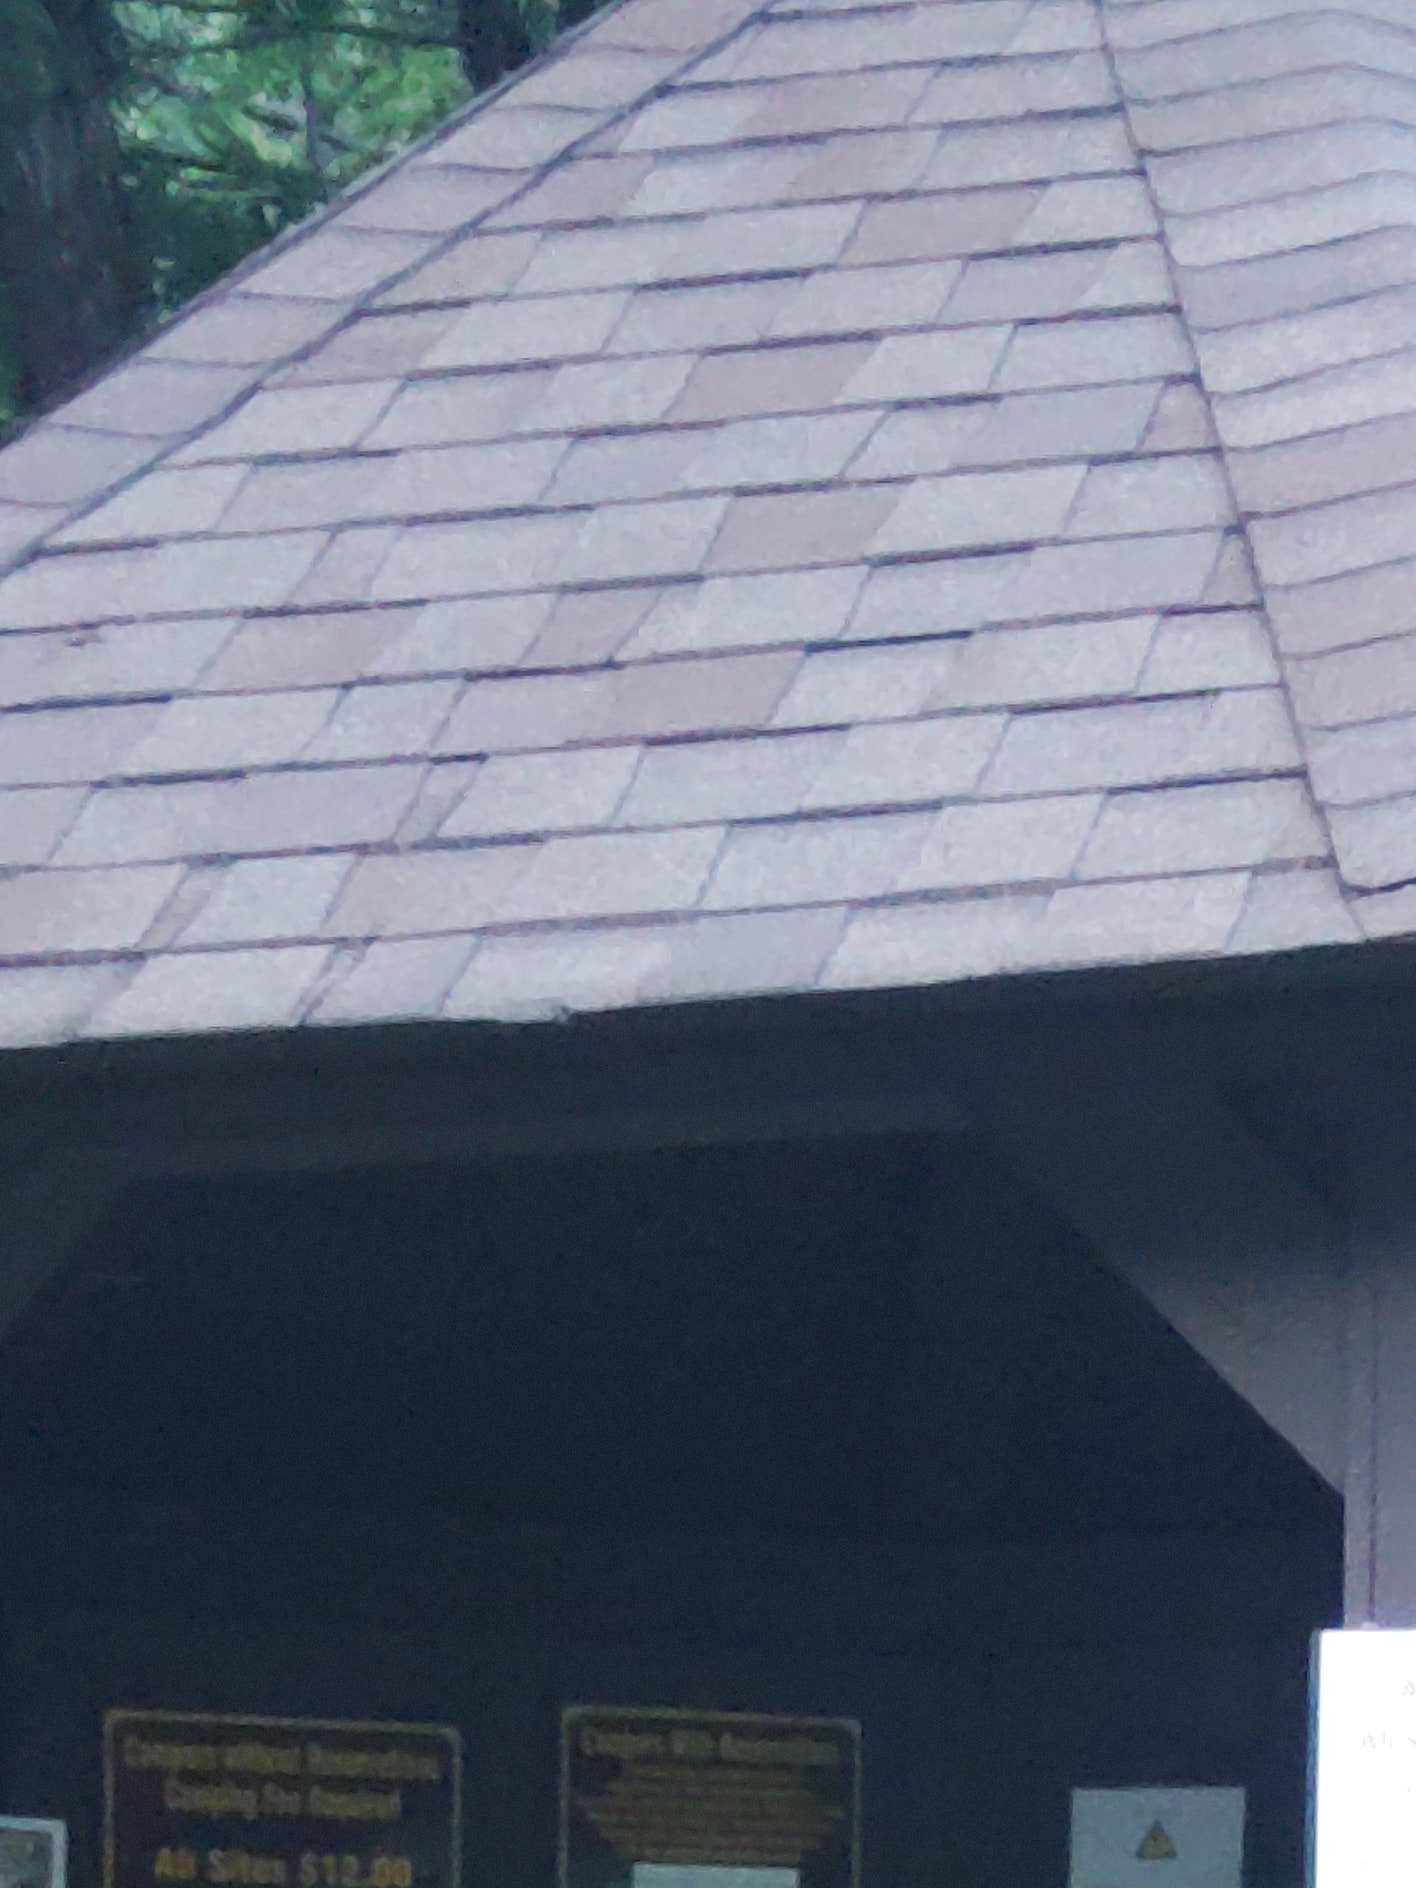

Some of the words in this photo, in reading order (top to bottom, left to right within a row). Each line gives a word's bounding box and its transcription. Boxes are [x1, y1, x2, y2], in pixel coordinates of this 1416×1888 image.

[154, 1848, 197, 1881] All
[206, 1848, 286, 1886] Sites
[299, 1851, 412, 1888] $12.00
